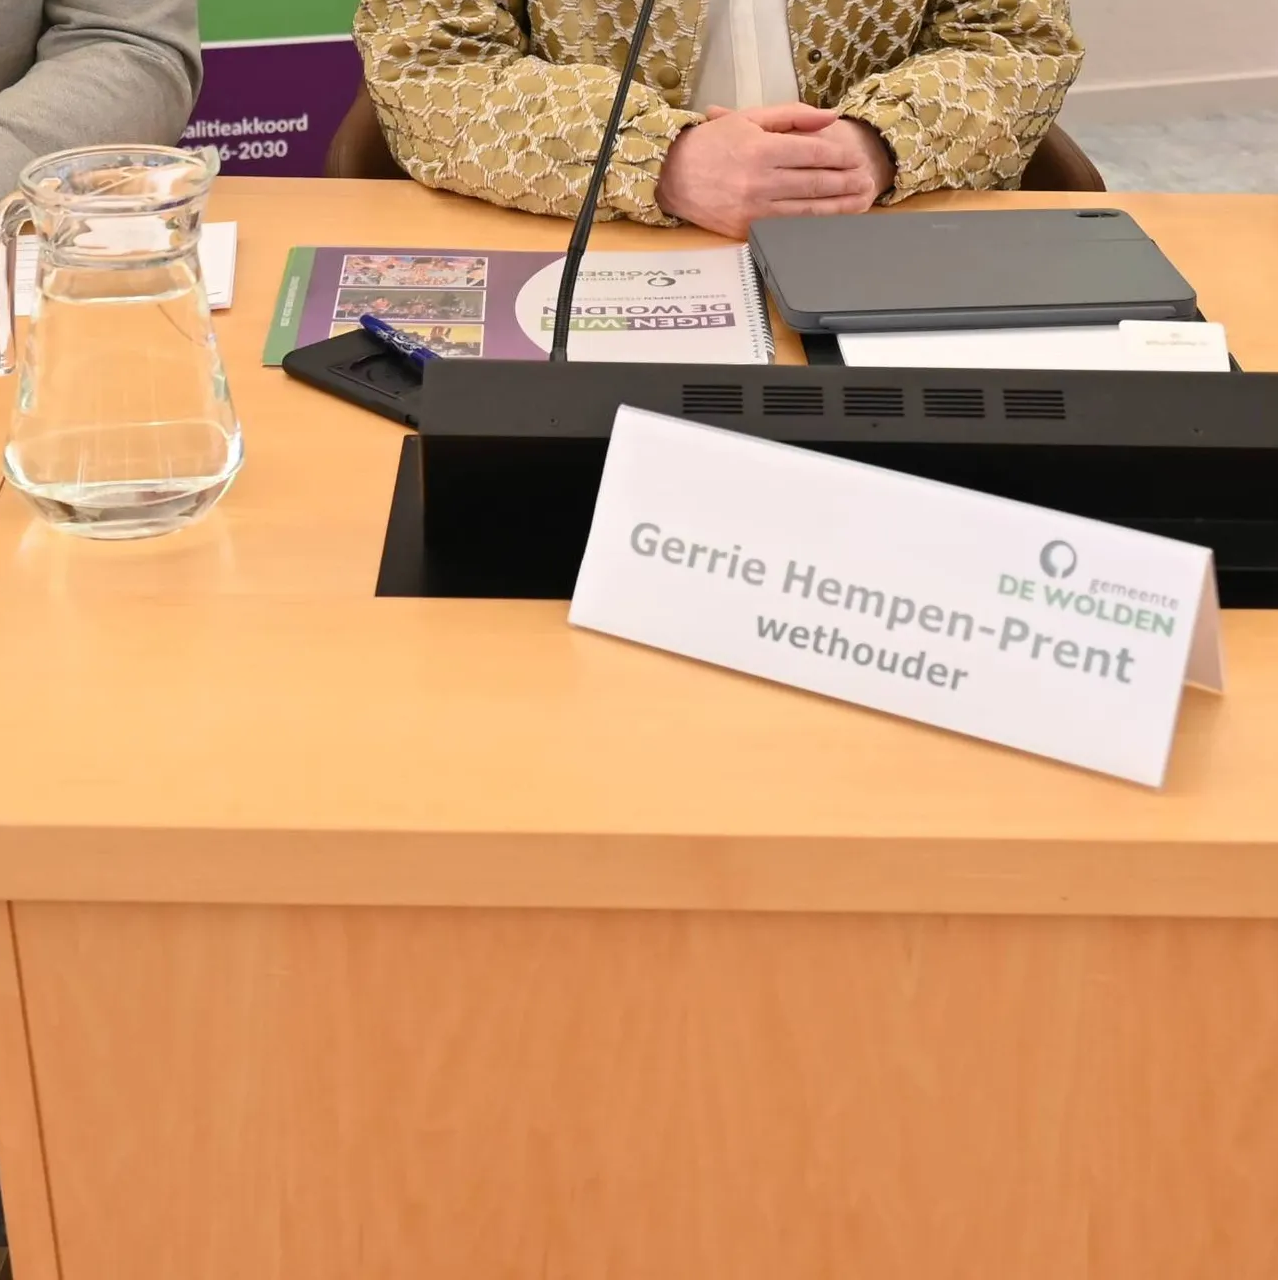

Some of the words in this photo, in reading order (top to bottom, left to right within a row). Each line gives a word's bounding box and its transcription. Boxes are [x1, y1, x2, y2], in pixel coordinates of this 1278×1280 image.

[181, 112, 309, 139] alitieakkoord
[691, 302, 731, 313] DE
[629, 522, 767, 587] Gerrie
[782, 560, 1136, 685] Hempen-Prent
[997, 573, 1035, 602] DE
[1043, 584, 1175, 637] WOLDEN
[1089, 576, 1179, 611] gemeente
[755, 615, 969, 691] wethouder
